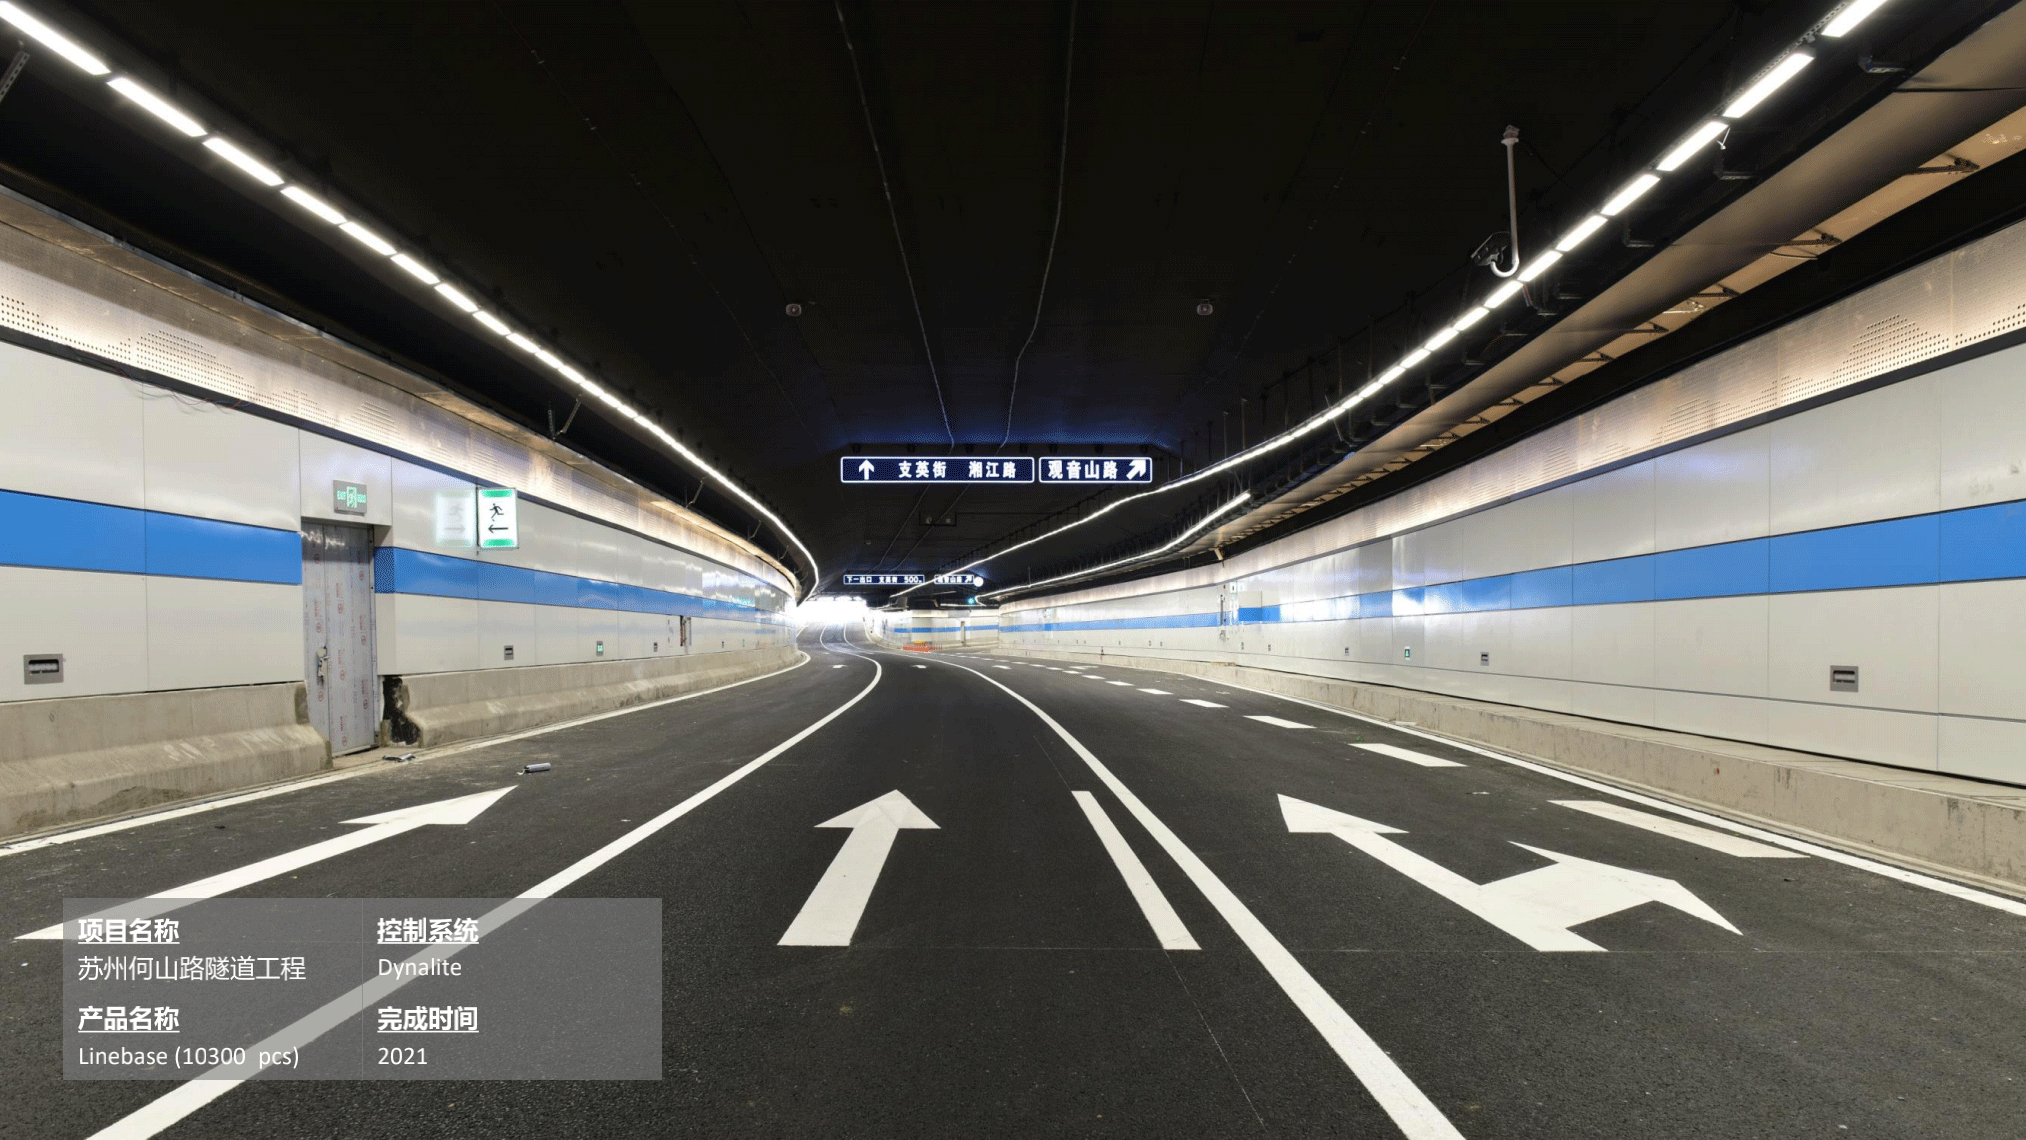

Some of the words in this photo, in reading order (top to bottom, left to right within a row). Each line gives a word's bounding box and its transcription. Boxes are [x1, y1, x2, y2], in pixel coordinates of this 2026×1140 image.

[898, 460, 947, 479] 支英街
[968, 460, 1017, 479] 湘江路
[1047, 459, 1118, 480] 观音山路
